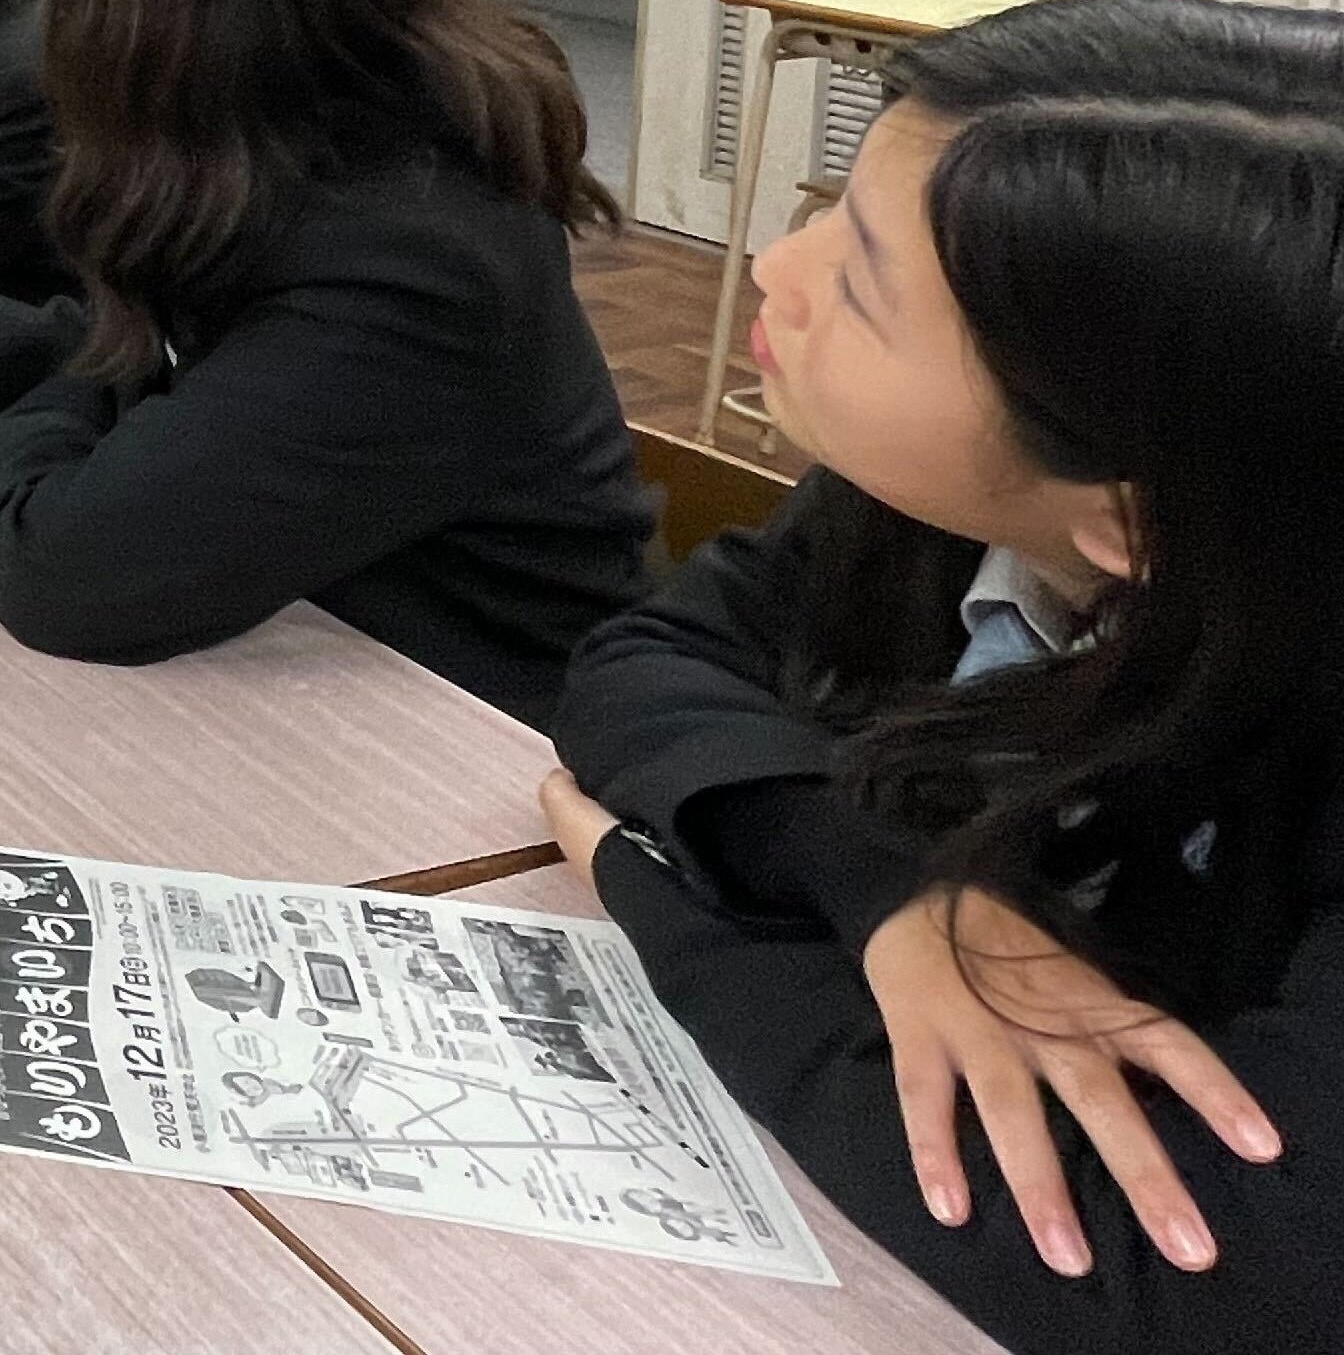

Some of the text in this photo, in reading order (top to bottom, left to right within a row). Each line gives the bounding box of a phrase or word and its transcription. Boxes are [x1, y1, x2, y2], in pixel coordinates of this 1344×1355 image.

[11, 914, 102, 1141] もりやまいち
